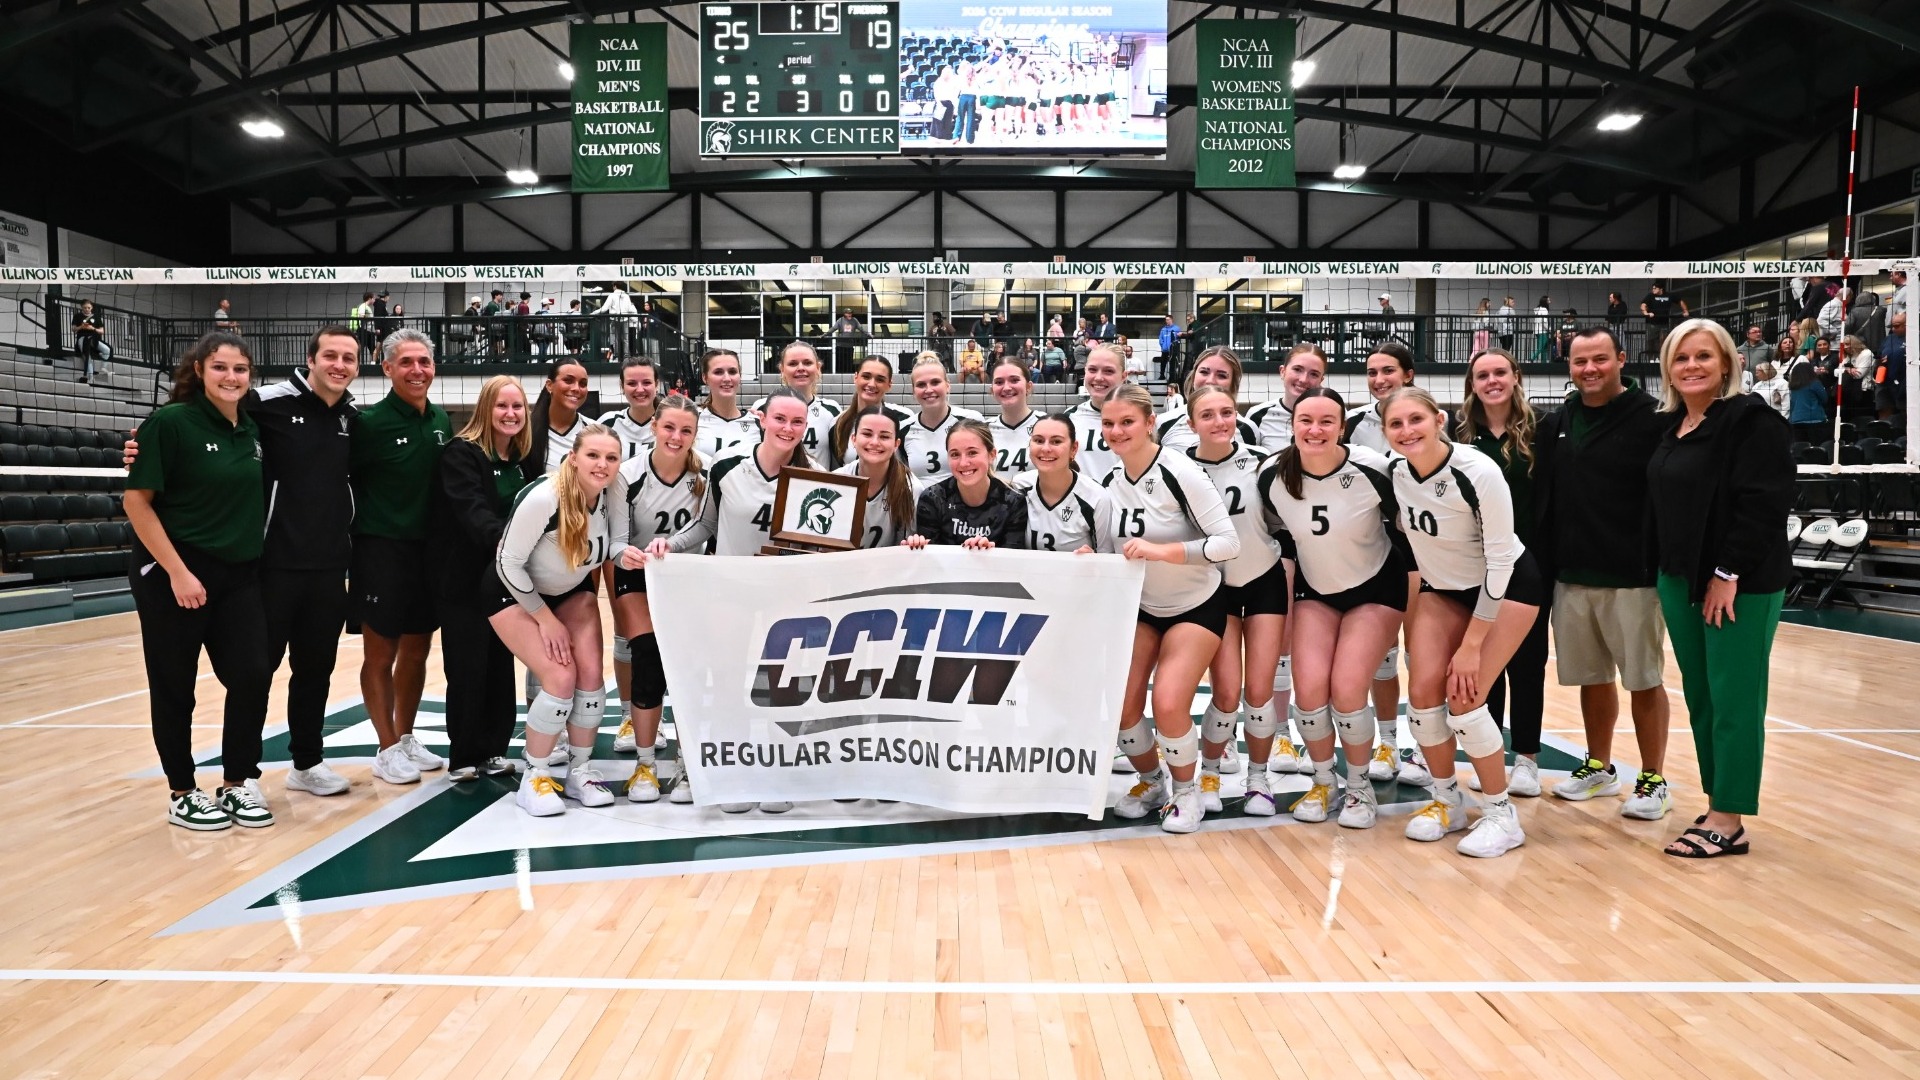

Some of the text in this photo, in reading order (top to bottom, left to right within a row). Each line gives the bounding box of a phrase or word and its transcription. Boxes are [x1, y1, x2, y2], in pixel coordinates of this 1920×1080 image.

[790, 4, 838, 31] 1:15
[1019, 7, 1069, 17] REGULAR
[1071, 7, 1112, 17] SEASON
[714, 22, 749, 50] 25
[868, 20, 891, 49] 19
[600, 39, 638, 50] NCAA
[1223, 39, 1269, 51] NCAA
[597, 60, 640, 71] DIV. III
[787, 55, 812, 65] period
[1221, 55, 1272, 68] DIV. III
[598, 80, 640, 92] MEN'S
[1212, 81, 1281, 93] WOMEN'S
[575, 100, 664, 114] BASKETBALL
[723, 92, 735, 113] 2
[746, 92, 759, 113] 2
[797, 90, 809, 112] 3
[840, 90, 853, 112] 0
[877, 90, 889, 112] 0
[1203, 98, 1291, 110] BASKETBALL
[585, 122, 654, 135] NATIONAL
[1205, 121, 1286, 134] NATIONAL
[737, 128, 894, 145] SHIRK CENTER
[579, 143, 660, 156] CHAMPIONS
[1202, 138, 1291, 150] CHAMPIONS
[608, 164, 633, 176] 1997
[1229, 159, 1263, 172] 2012
[2, 269, 133, 280] ILLINOIS WESLEYAN
[207, 268, 336, 279] ILLINOIS WESLEYAN
[411, 267, 543, 278] ILLINOIS WESLEYAN
[620, 265, 755, 277] ILLINOIS WESLEYAN
[833, 263, 969, 274] ILLINOIS WESLEYAN
[1048, 263, 1184, 274] ILLINOIS WESLEYAN
[1263, 263, 1399, 274] ILLINOIS WESLEYAN
[1476, 263, 1611, 274] ILLINOIS WESLEYAN
[1688, 262, 1824, 274] ILLINOIS WESLEYAN
[925, 450, 942, 473] 3
[996, 447, 1028, 471] 24
[654, 508, 692, 535] 20
[751, 503, 772, 532] 4
[1117, 508, 1146, 538] 15
[1311, 505, 1330, 536] 5
[1408, 506, 1438, 537] 10
[952, 518, 991, 537] Titans
[1031, 530, 1056, 550] 13
[750, 608, 1049, 707] CCIW
[700, 737, 1097, 776] REGULAR SEASON CHAMPION
